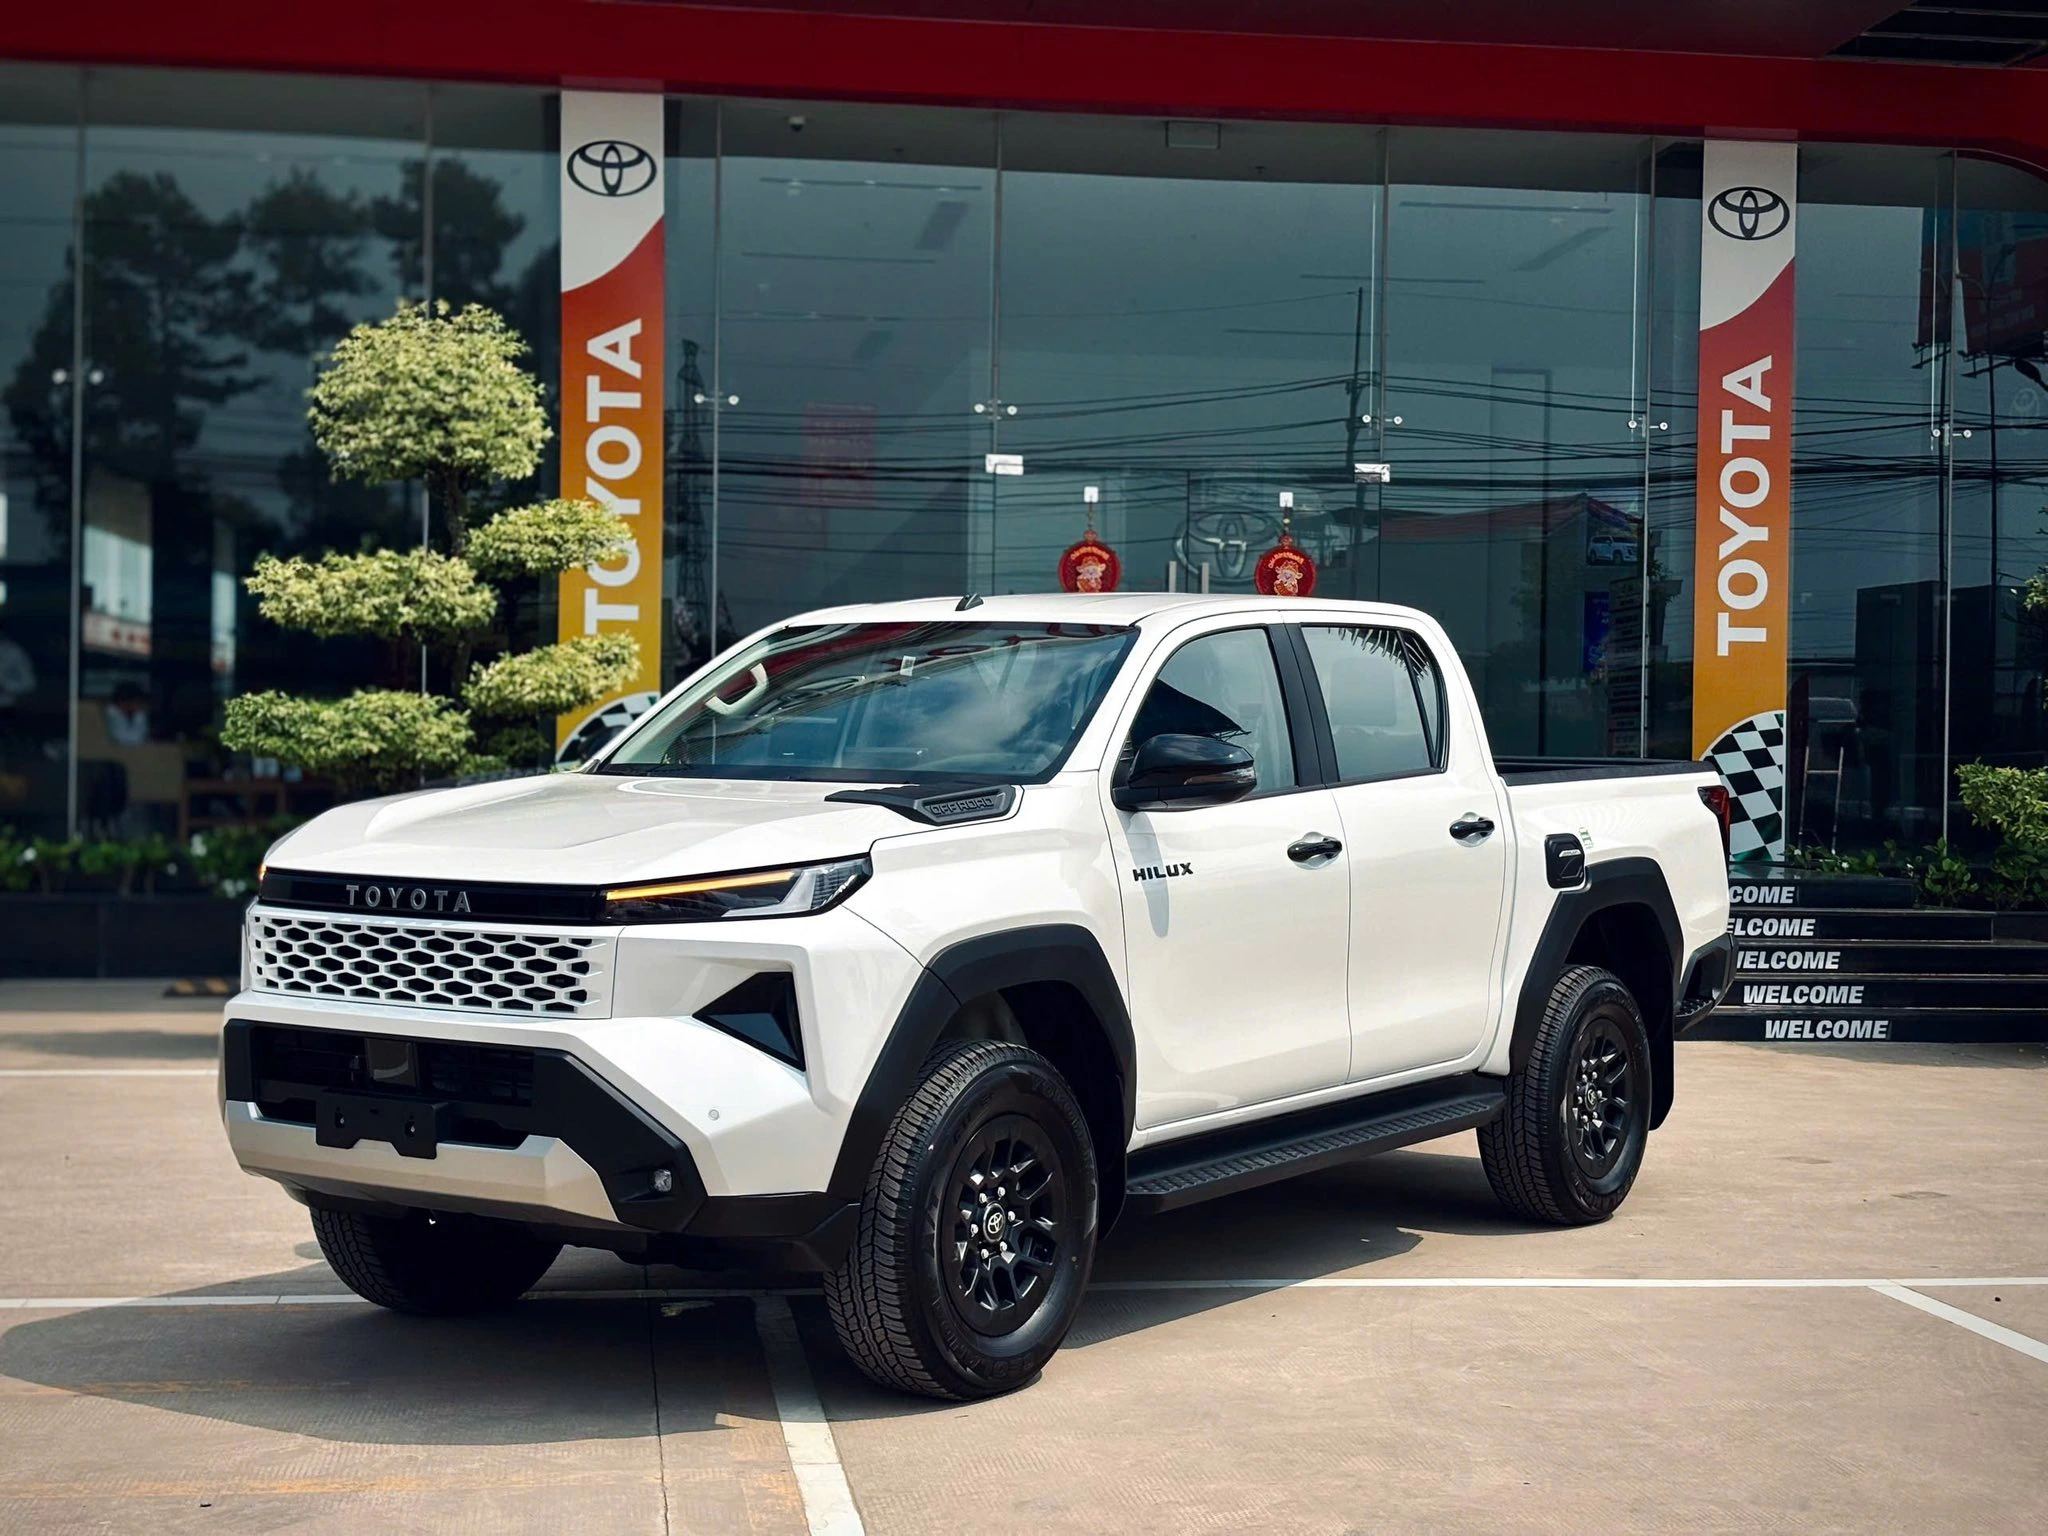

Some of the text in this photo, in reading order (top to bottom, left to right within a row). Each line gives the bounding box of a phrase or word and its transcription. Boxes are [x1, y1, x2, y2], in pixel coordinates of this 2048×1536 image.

[1717, 355, 1772, 656] TOYOTA
[1132, 862, 1194, 882] HILUX
[346, 884, 471, 913] TOYOTA
[1736, 951, 1841, 969] ELCOME
[1744, 985, 1864, 1004] WELCOME
[1766, 1020, 1888, 1039] WELCOME
